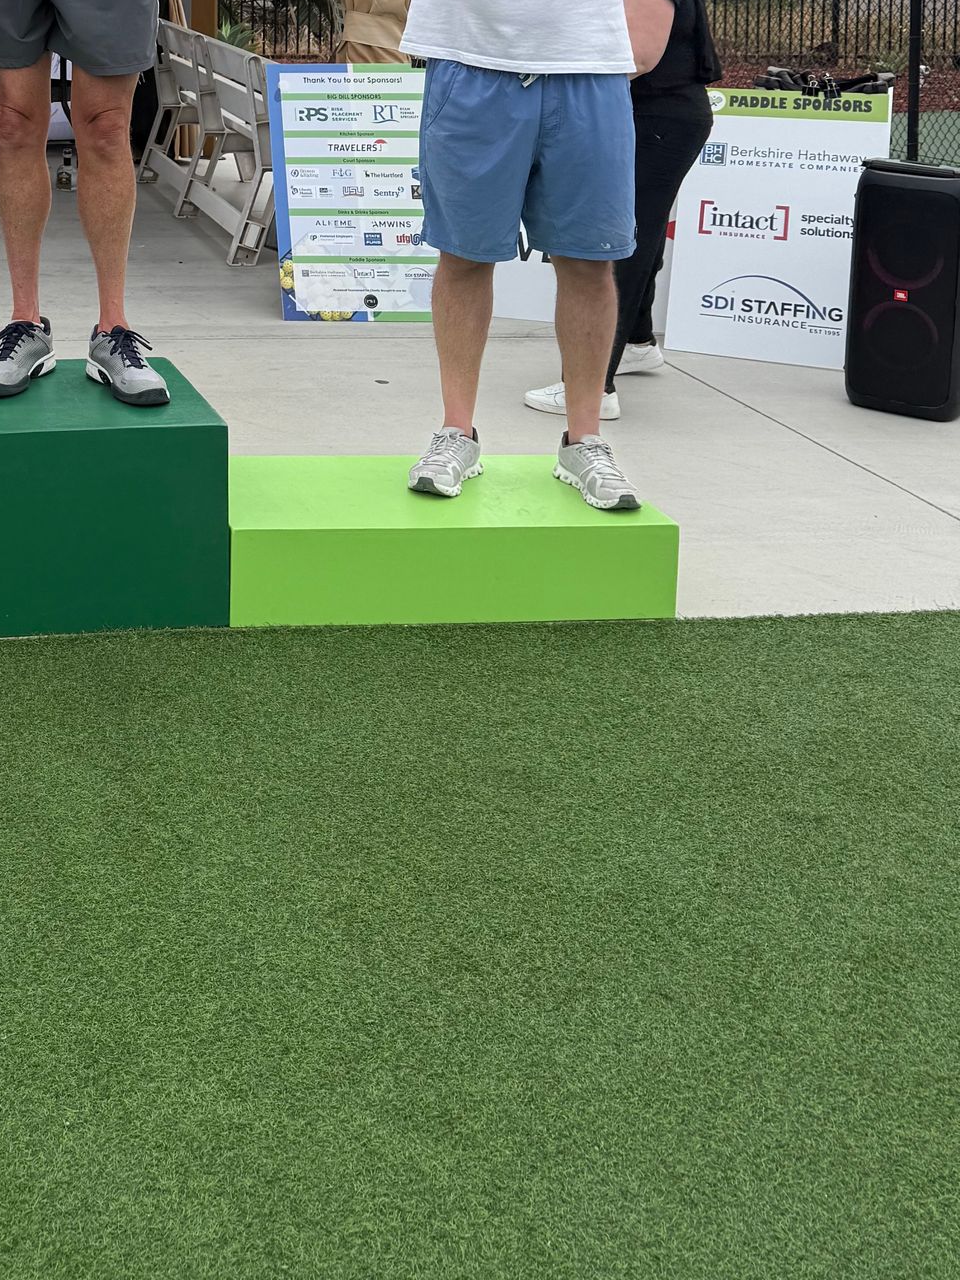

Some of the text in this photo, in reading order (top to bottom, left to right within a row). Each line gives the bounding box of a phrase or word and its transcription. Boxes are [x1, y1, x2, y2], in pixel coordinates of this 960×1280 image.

[729, 95, 873, 113] PADDLE SPONSORS
[298, 107, 328, 122] RPS
[372, 105, 398, 120] RT
[328, 144, 377, 152] TRAVELERS
[705, 145, 722, 154] BH
[730, 146, 866, 164] Berkshire Hathaway
[704, 154, 722, 163] HC
[730, 160, 793, 169] HOMESTATE
[374, 188, 399, 198] Sentry
[710, 206, 778, 231] intact
[801, 213, 854, 227] specialty
[719, 231, 766, 240] INSURANCE
[701, 294, 843, 322] SDI STAFFING
[733, 315, 807, 330] INSURANCE
